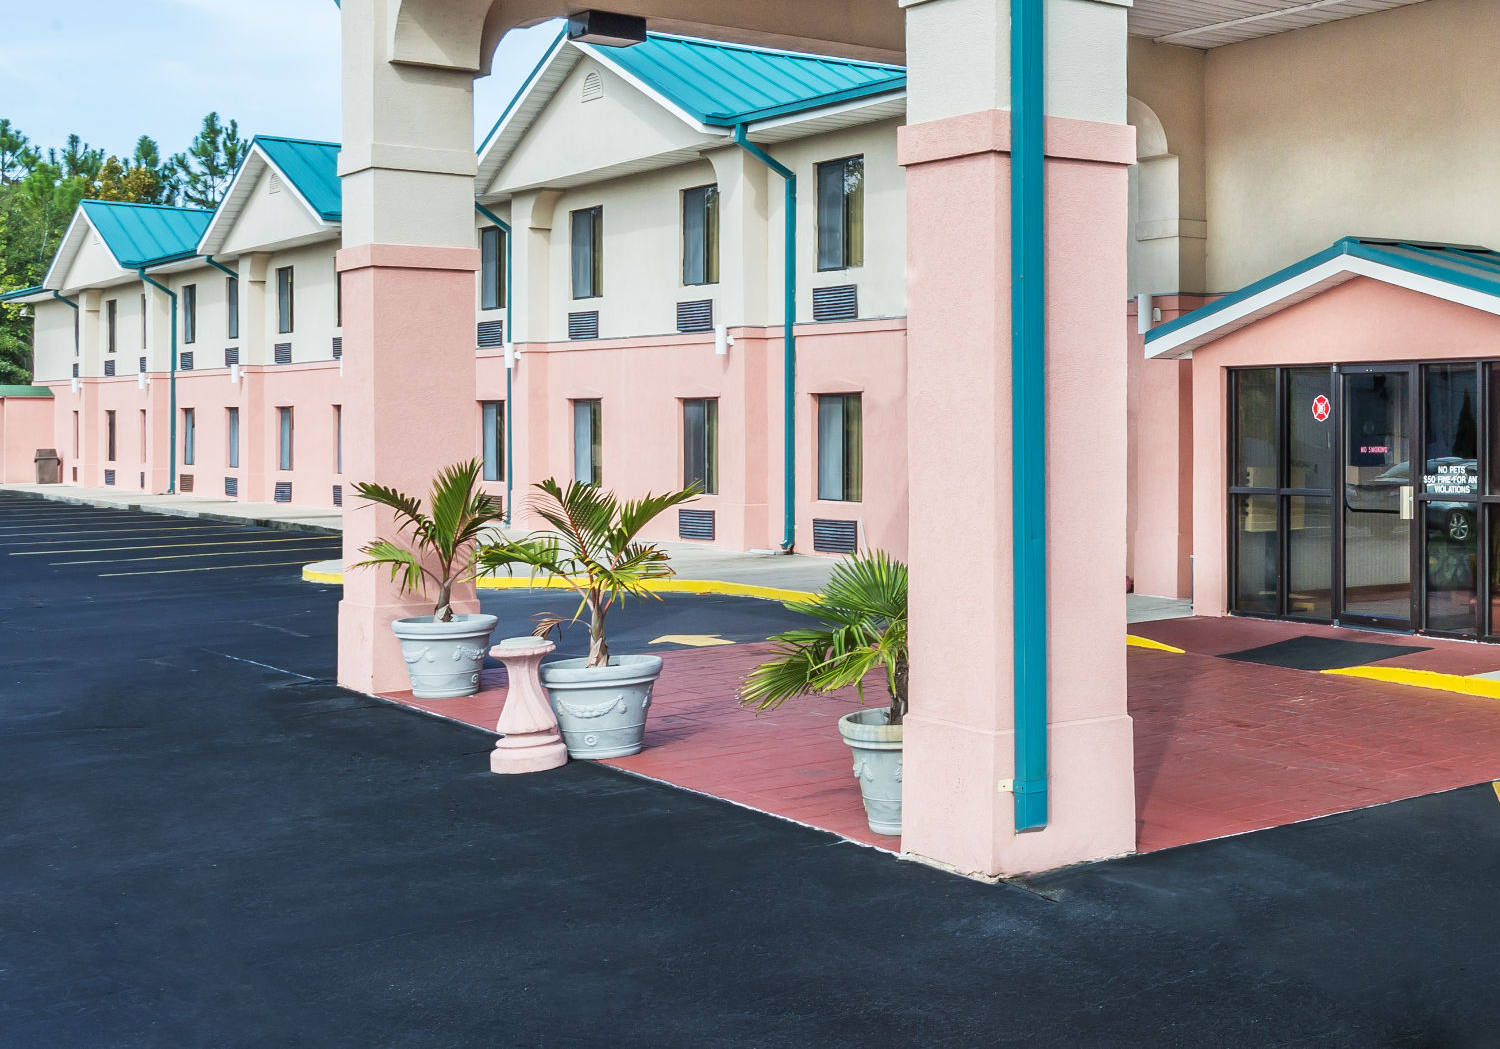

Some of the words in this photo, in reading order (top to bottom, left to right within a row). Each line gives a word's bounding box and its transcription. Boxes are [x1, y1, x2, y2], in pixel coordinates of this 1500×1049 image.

[1437, 465, 1448, 474] NO
[1449, 465, 1466, 474] PETS
[1423, 474, 1436, 484] $50
[1437, 475, 1452, 484] FINE
[1453, 475, 1467, 484] FOR
[1434, 485, 1471, 494] VIOLATIONS
